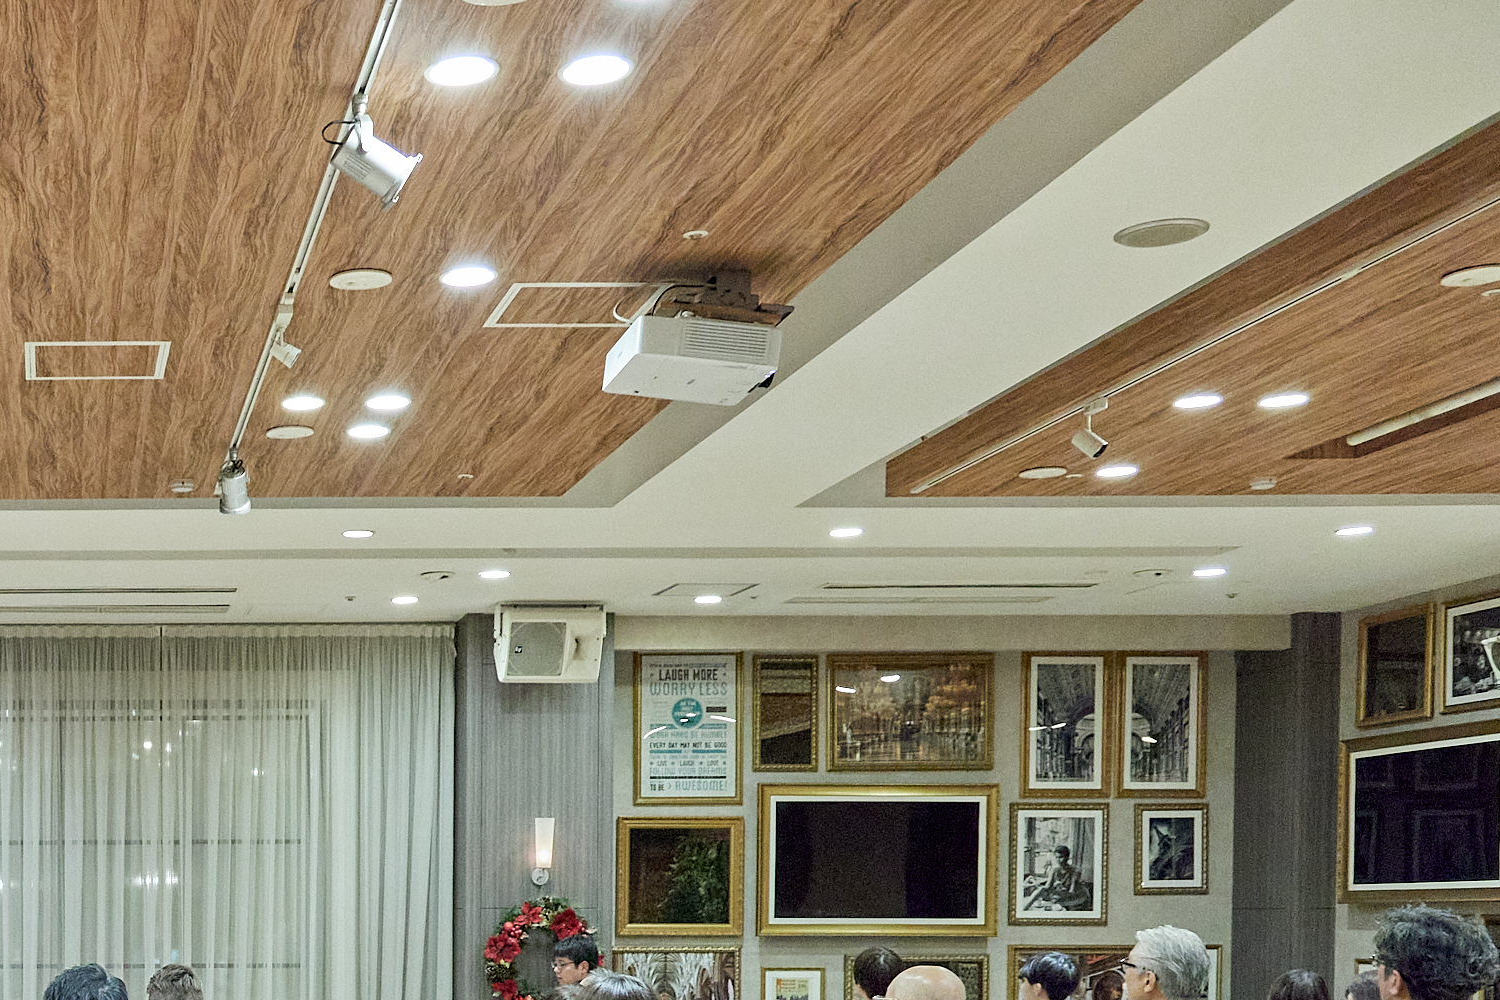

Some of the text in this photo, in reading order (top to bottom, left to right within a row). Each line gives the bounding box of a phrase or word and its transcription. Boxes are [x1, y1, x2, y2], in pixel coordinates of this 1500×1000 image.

[659, 669, 718, 681] LAUGH MORE
[650, 682, 728, 696] WORRY LESS
[674, 780, 728, 792] AWESOME!
